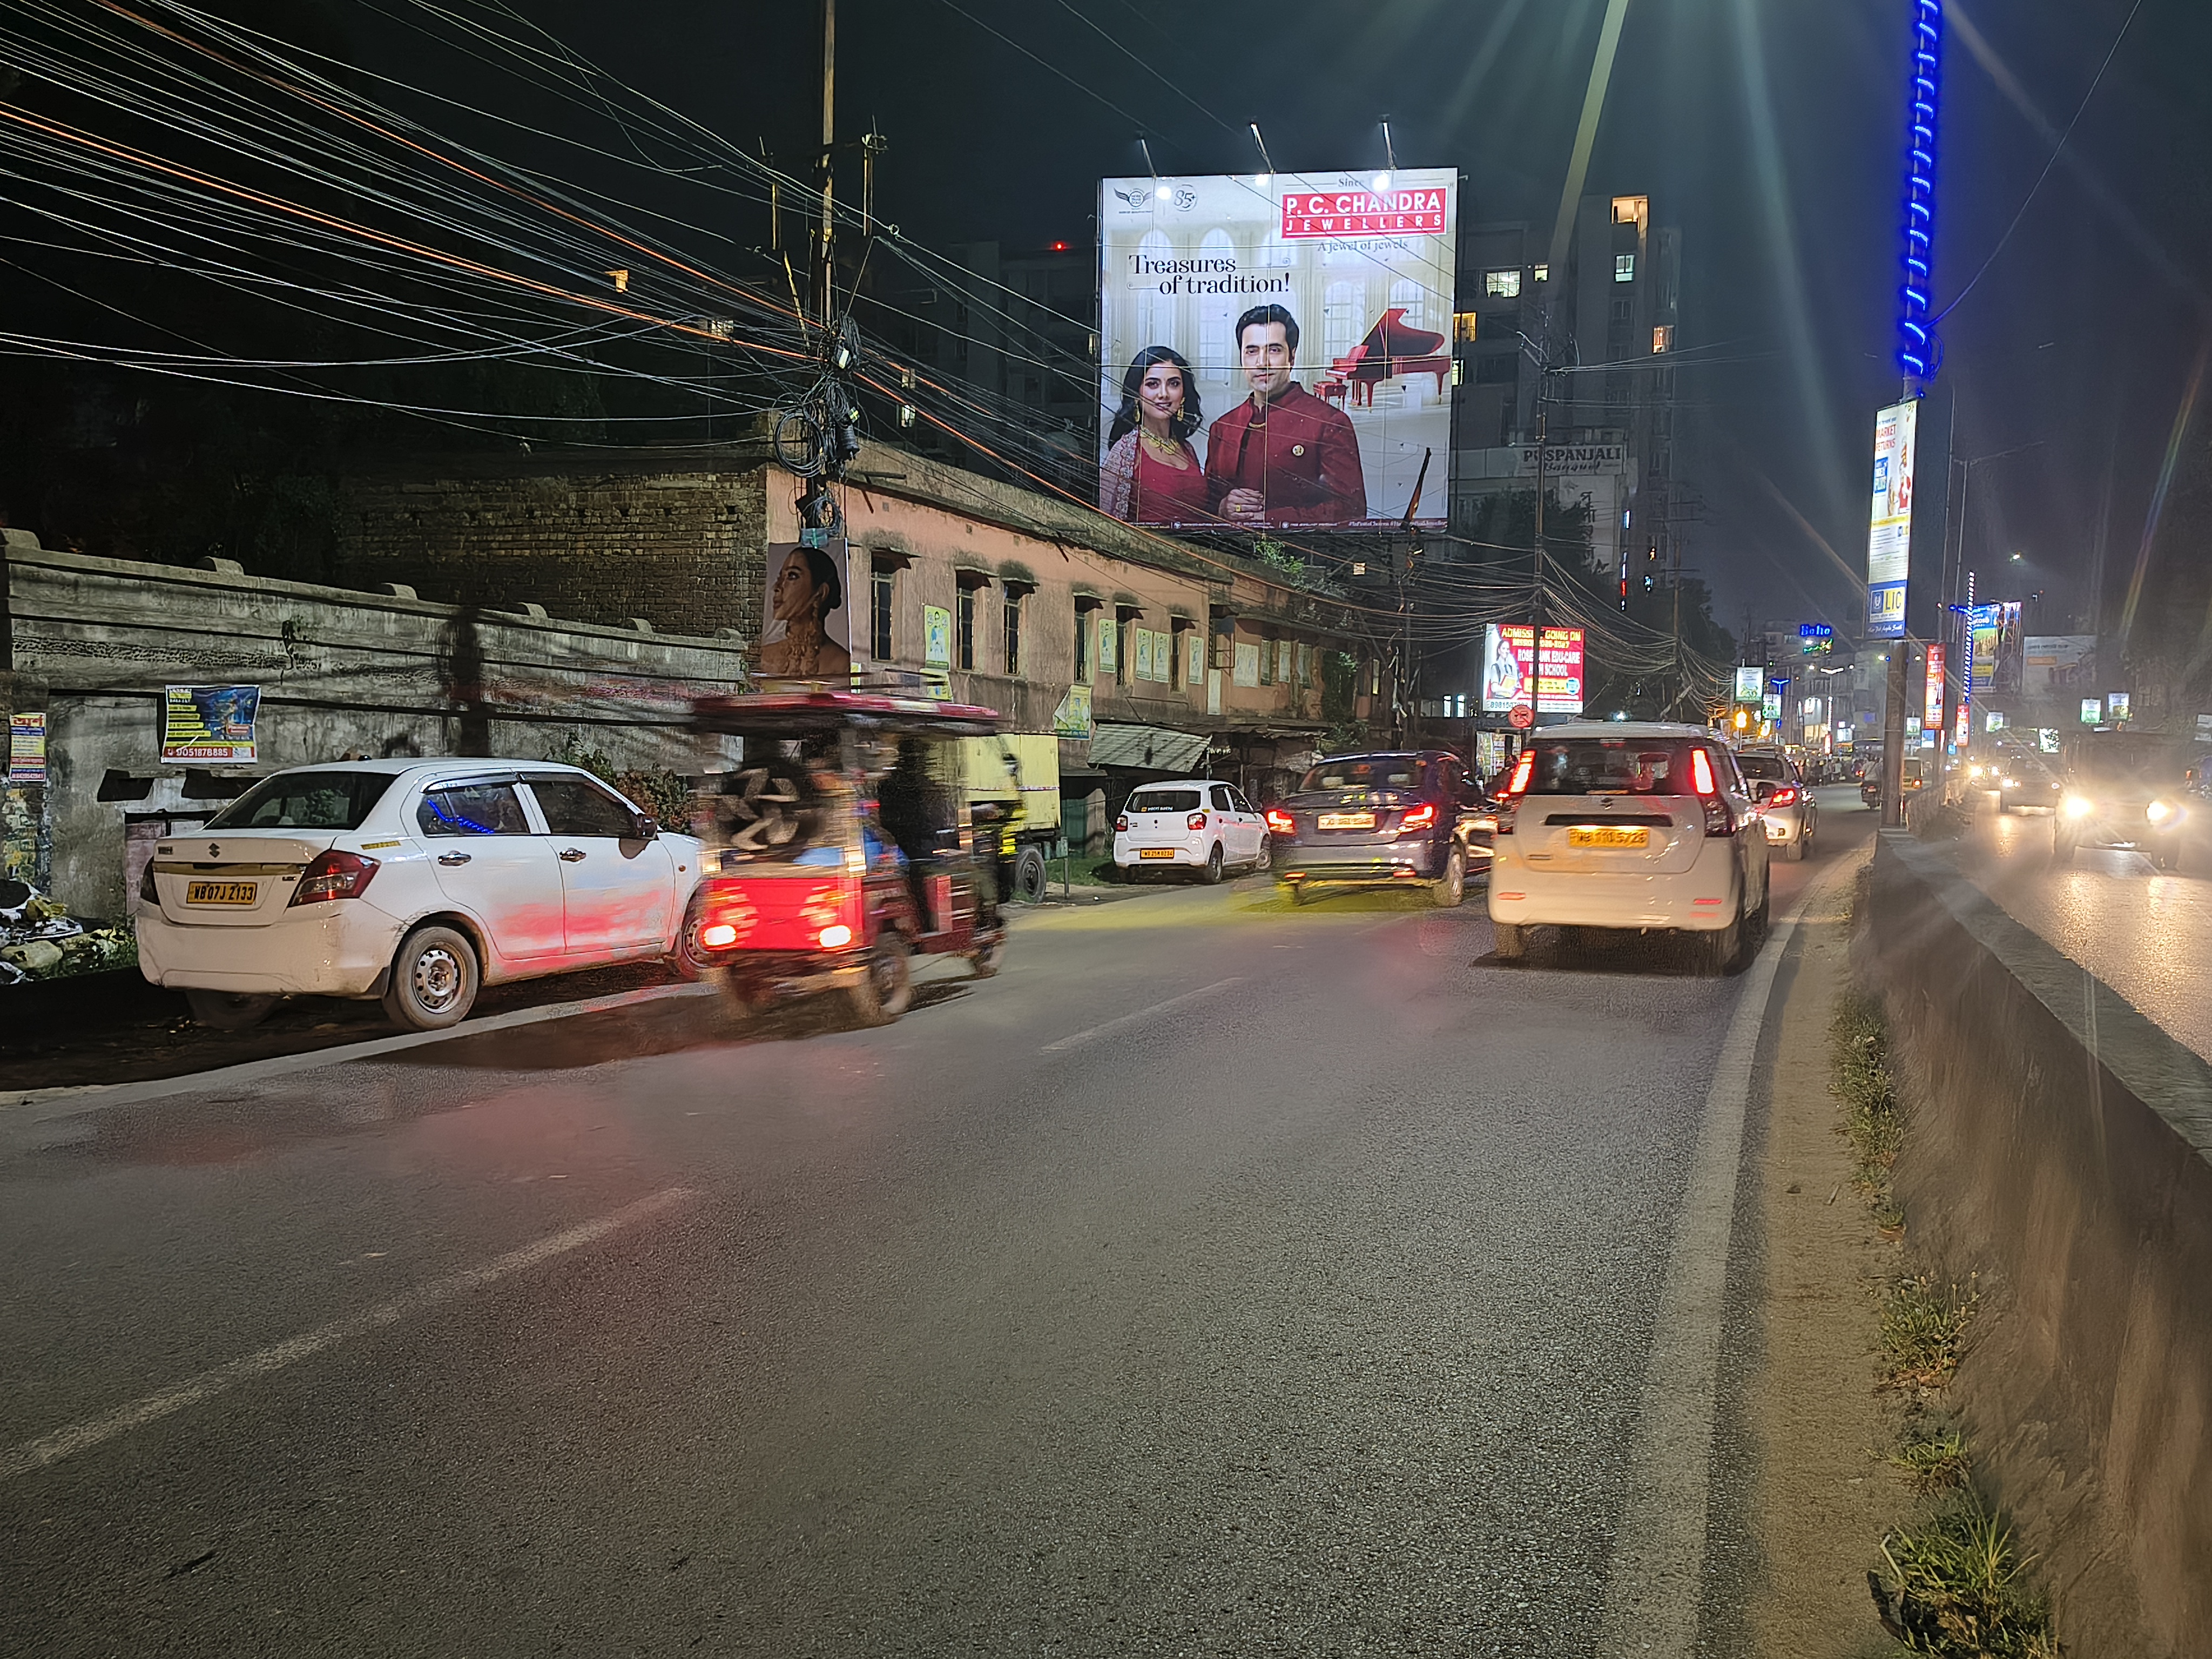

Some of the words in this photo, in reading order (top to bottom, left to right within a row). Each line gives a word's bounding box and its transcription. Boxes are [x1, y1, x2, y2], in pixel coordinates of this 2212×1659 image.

[1286, 197, 1302, 214] P.
[1308, 196, 1329, 214] C.
[1336, 192, 1441, 213] CHANDRA
[1285, 214, 1441, 232] JEWELLERS
[1129, 255, 1236, 274] Treasures
[1159, 275, 1183, 294] of
[1185, 272, 1290, 294] tradition!
[1885, 591, 1902, 610] LIC
[1501, 628, 1543, 639] ADMISSI
[1545, 630, 1568, 640] GOING
[1570, 631, 1581, 641] ON
[1518, 649, 1550, 663] ROSEANK
[1529, 662, 1544, 676] HH
[1545, 663, 1569, 677] SCHOOL
